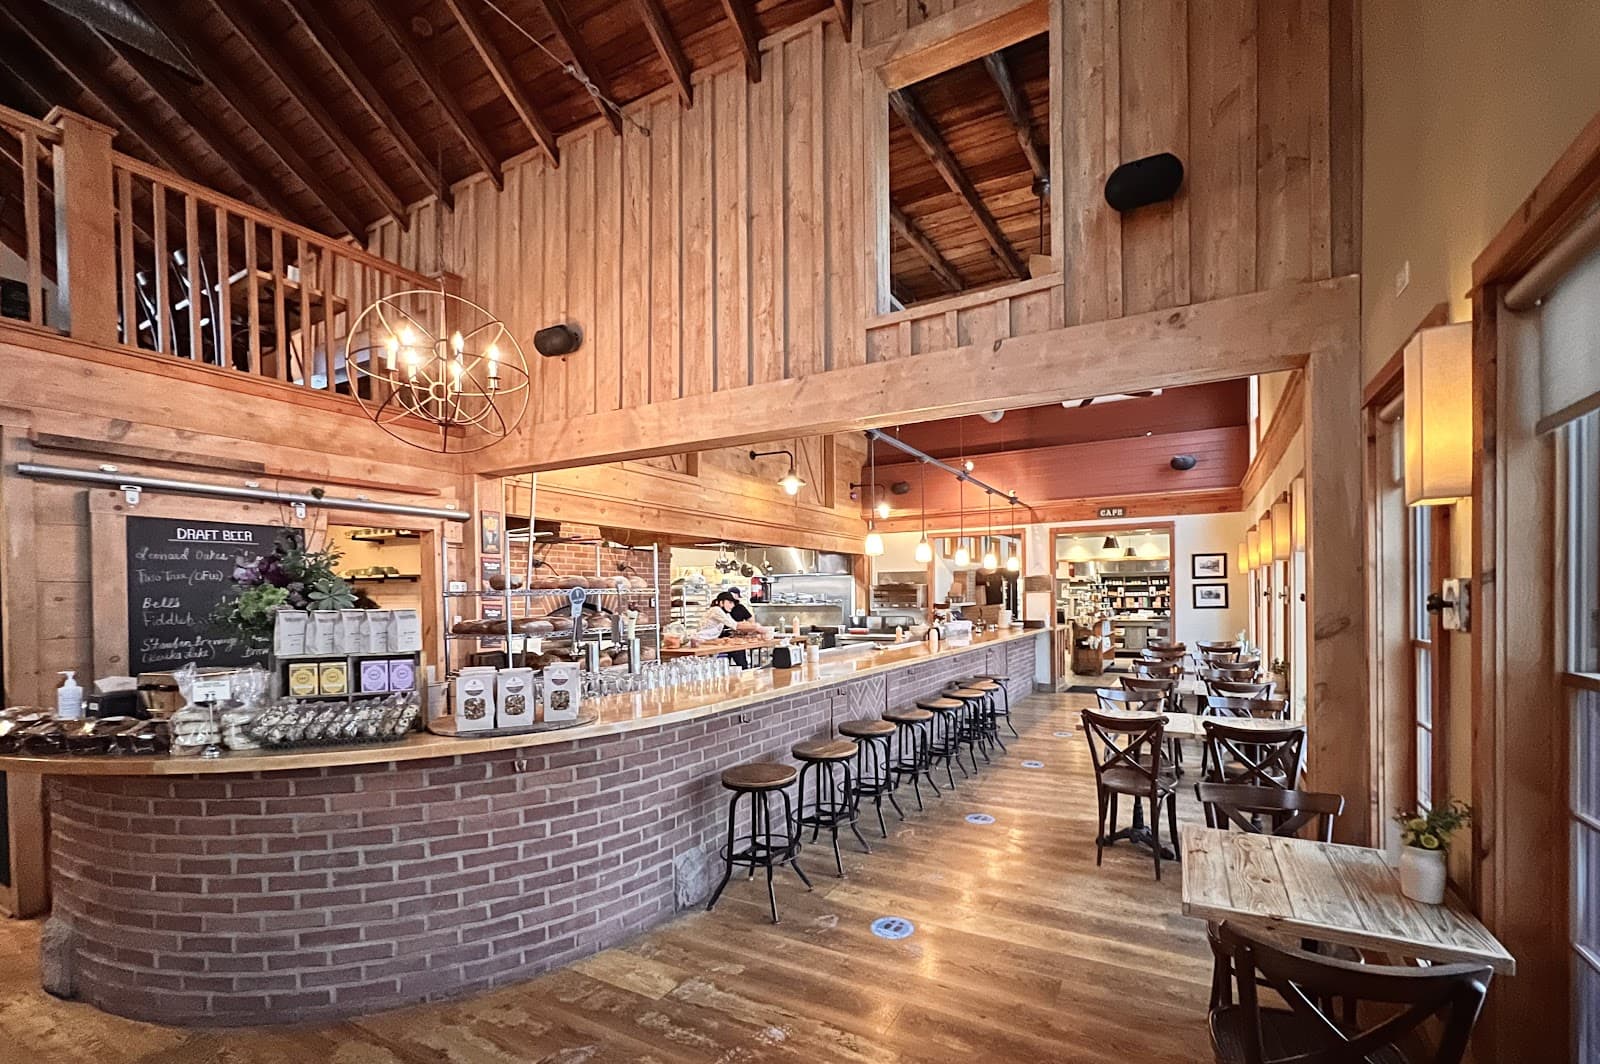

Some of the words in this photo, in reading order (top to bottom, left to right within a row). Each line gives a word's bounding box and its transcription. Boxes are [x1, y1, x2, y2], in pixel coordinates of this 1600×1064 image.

[1100, 508, 1123, 517] CAFE
[176, 527, 220, 541] DRAFT
[222, 529, 253, 542] BEER
